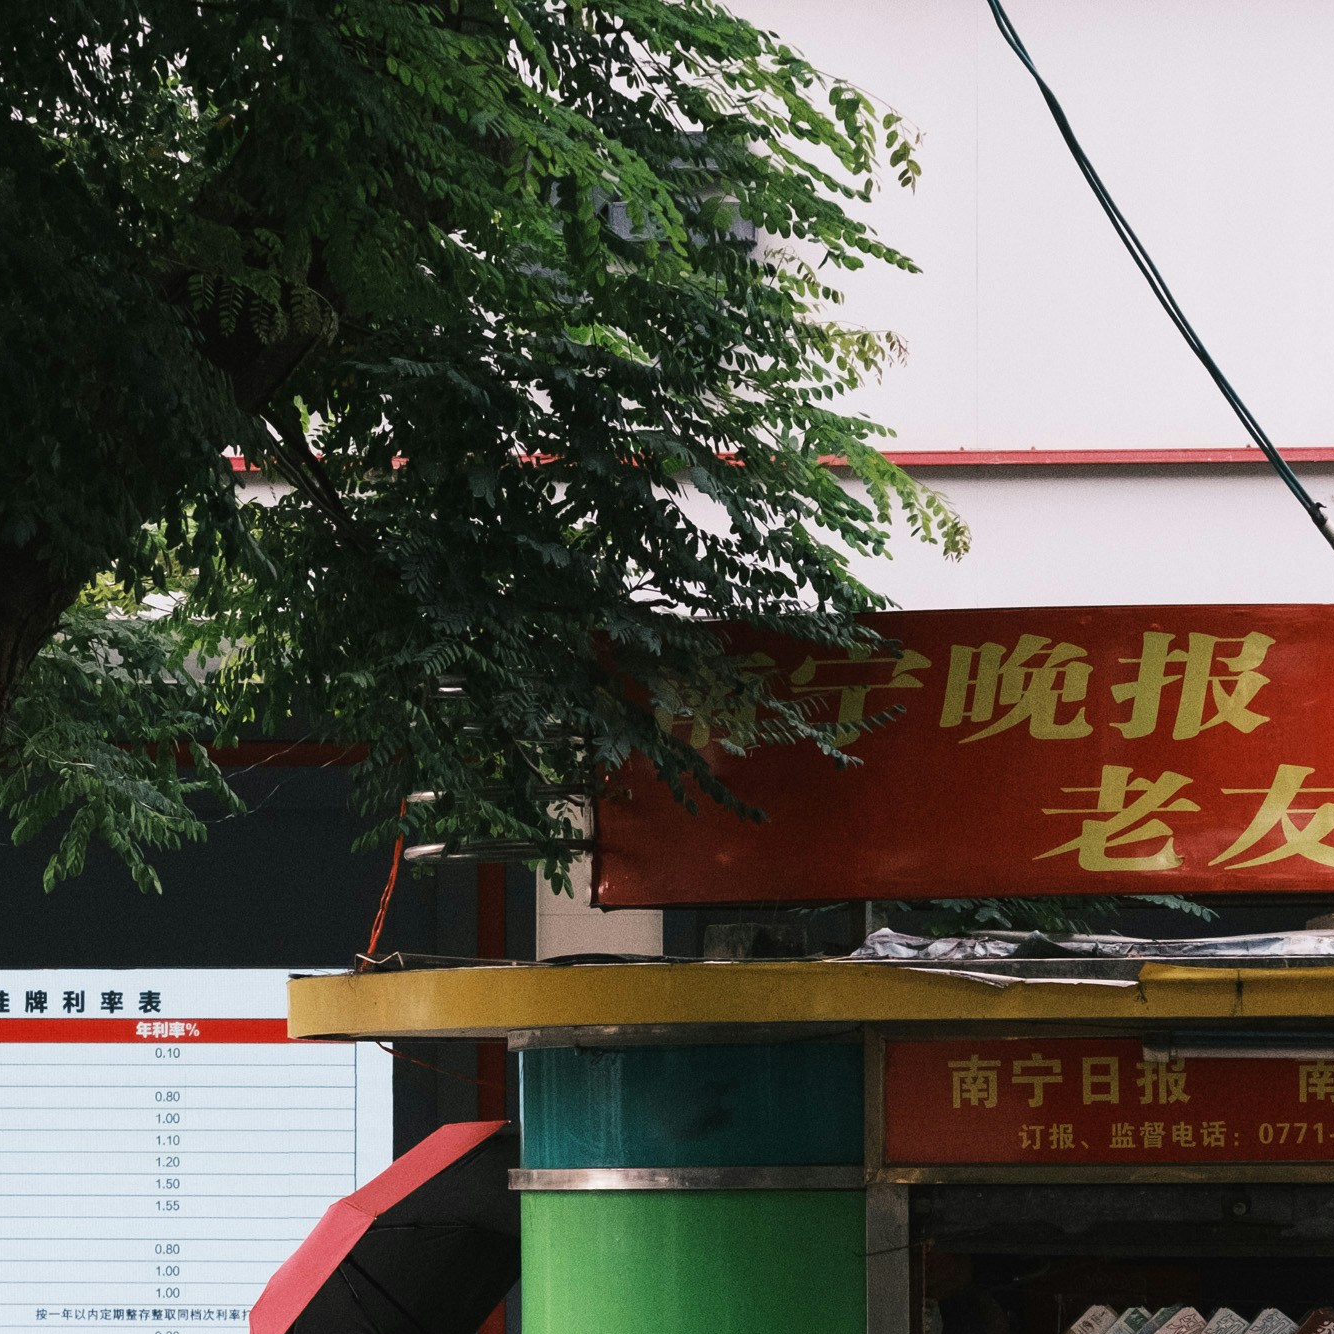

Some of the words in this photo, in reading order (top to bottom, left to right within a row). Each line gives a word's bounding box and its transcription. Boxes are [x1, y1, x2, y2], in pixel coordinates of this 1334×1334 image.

[136, 1022, 200, 1038] 年利率%
[155, 1048, 180, 1059] 0.10
[949, 1054, 1191, 1108] 南宁日报
[155, 1091, 180, 1102] 0.80
[155, 1113, 180, 1124] 1.00
[155, 1135, 180, 1146] 1.10
[155, 1157, 180, 1168] 1.20
[155, 1179, 180, 1190] 1.50
[155, 1200, 180, 1211] 1.55
[155, 1244, 180, 1255] 0.80
[155, 1266, 180, 1277] 1.00
[155, 1288, 180, 1298] 1.00
